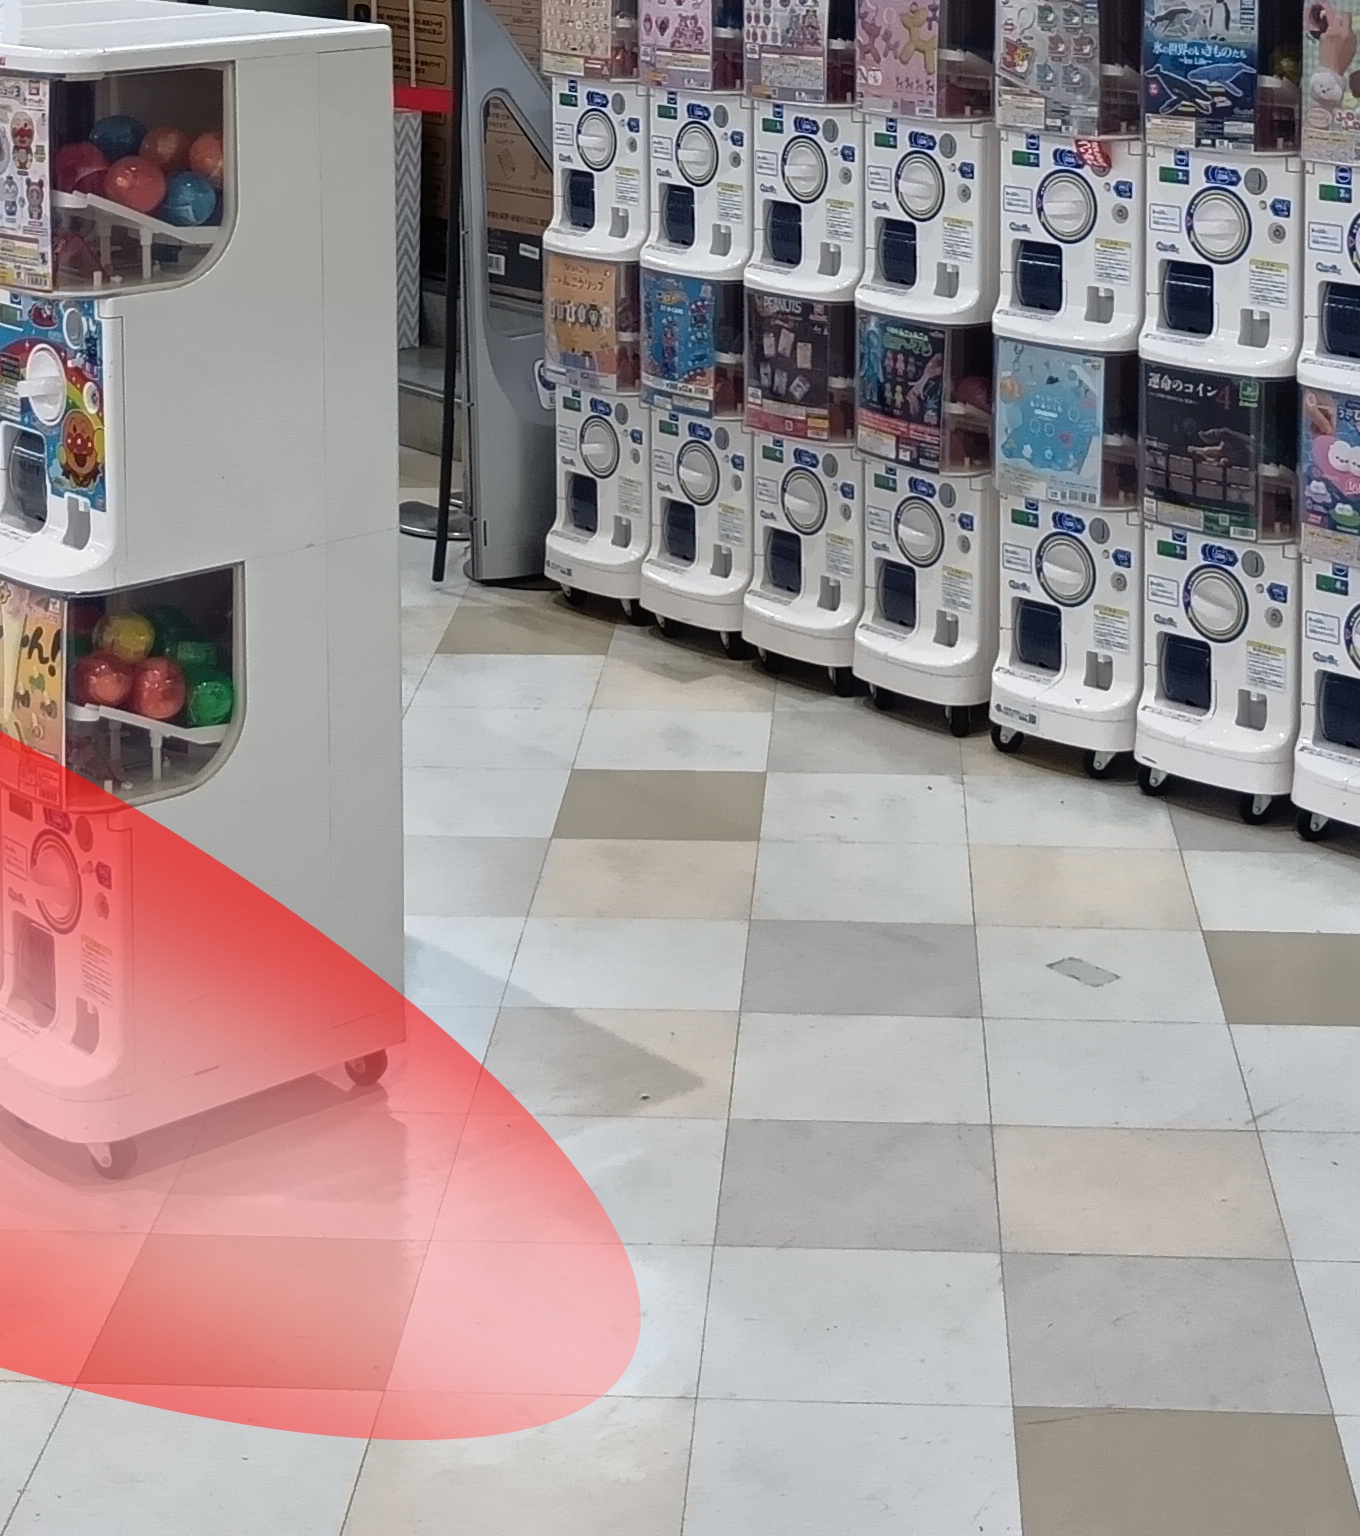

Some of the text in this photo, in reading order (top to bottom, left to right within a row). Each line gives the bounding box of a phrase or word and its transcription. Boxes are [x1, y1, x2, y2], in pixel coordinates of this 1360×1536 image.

[1152, 40, 1248, 59] 氷の世界のいきものたち
[763, 295, 802, 314] PEANUTS
[1147, 371, 1233, 410] 運命のコイン 4
